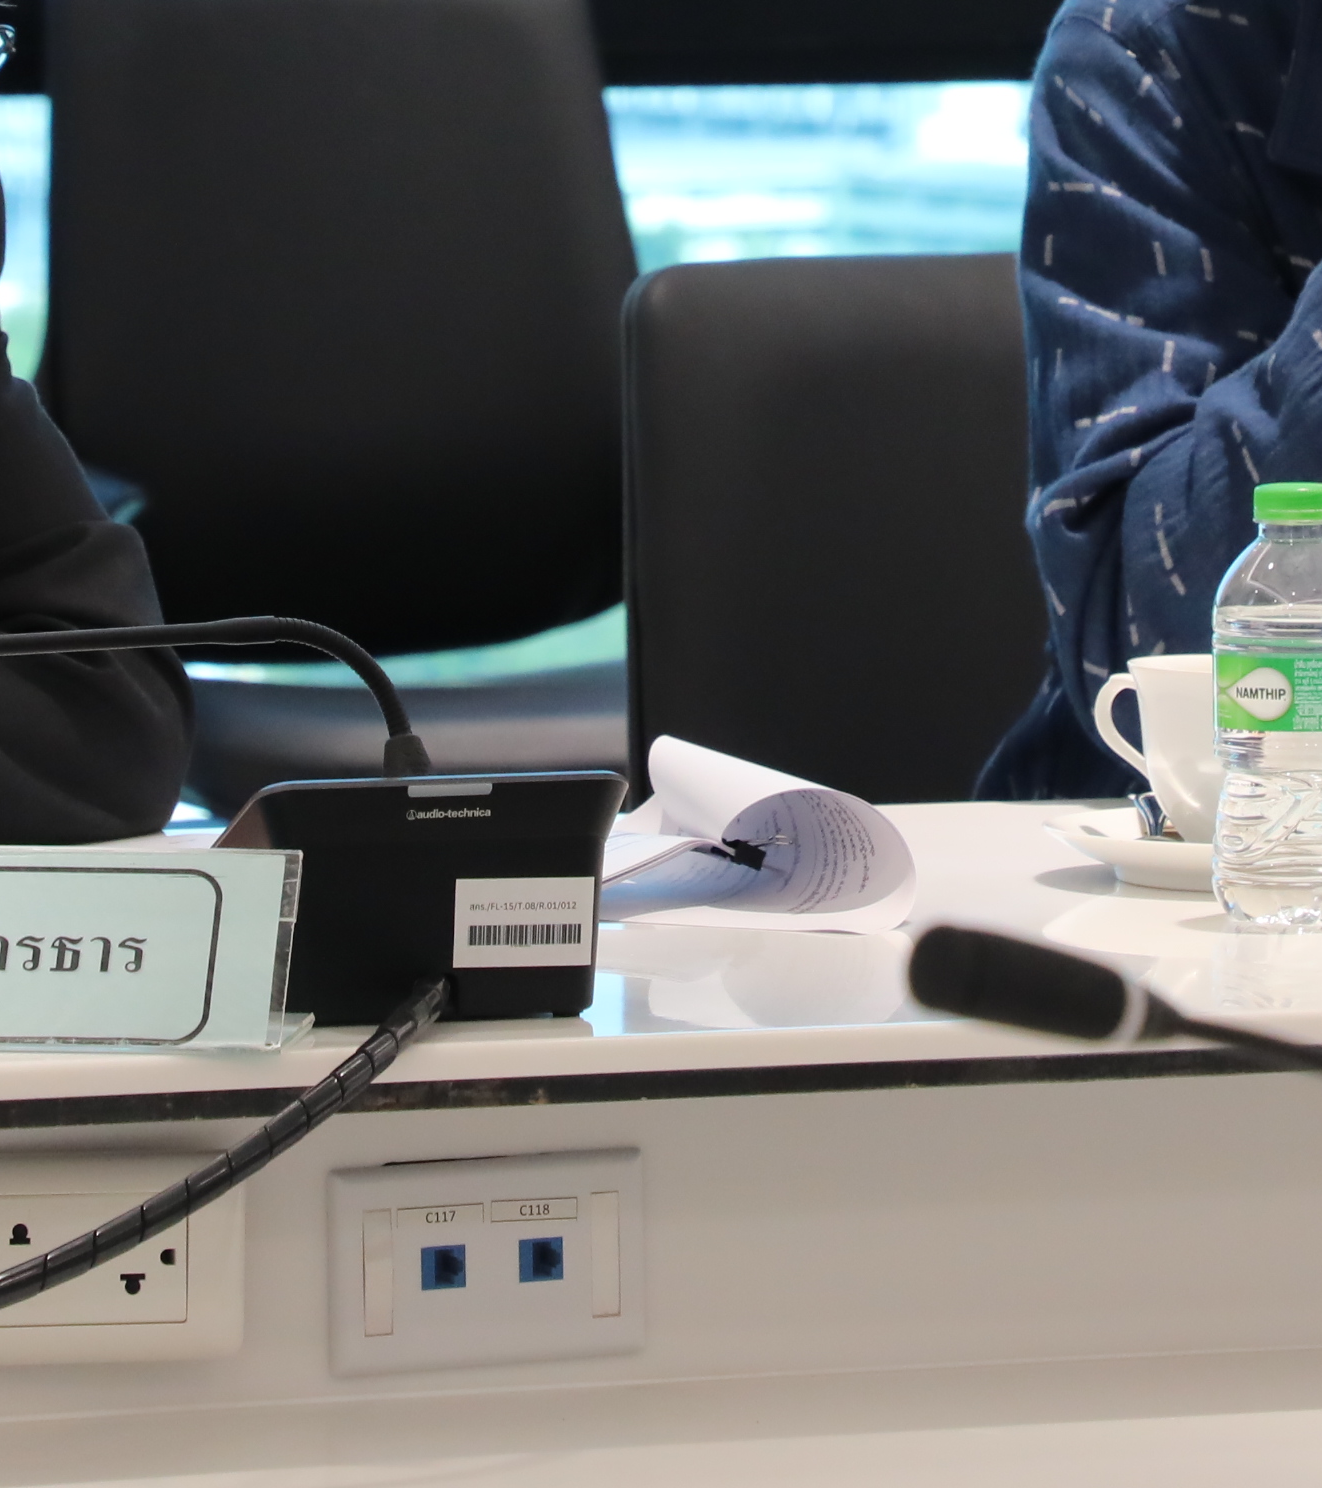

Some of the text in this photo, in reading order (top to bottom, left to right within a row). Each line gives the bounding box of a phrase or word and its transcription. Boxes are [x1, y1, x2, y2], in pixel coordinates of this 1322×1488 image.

[1235, 686, 1287, 701] NAMTHIP
[416, 807, 492, 820] audio-technica
[425, 1210, 457, 1224] C117
[519, 1203, 551, 1217] C118
